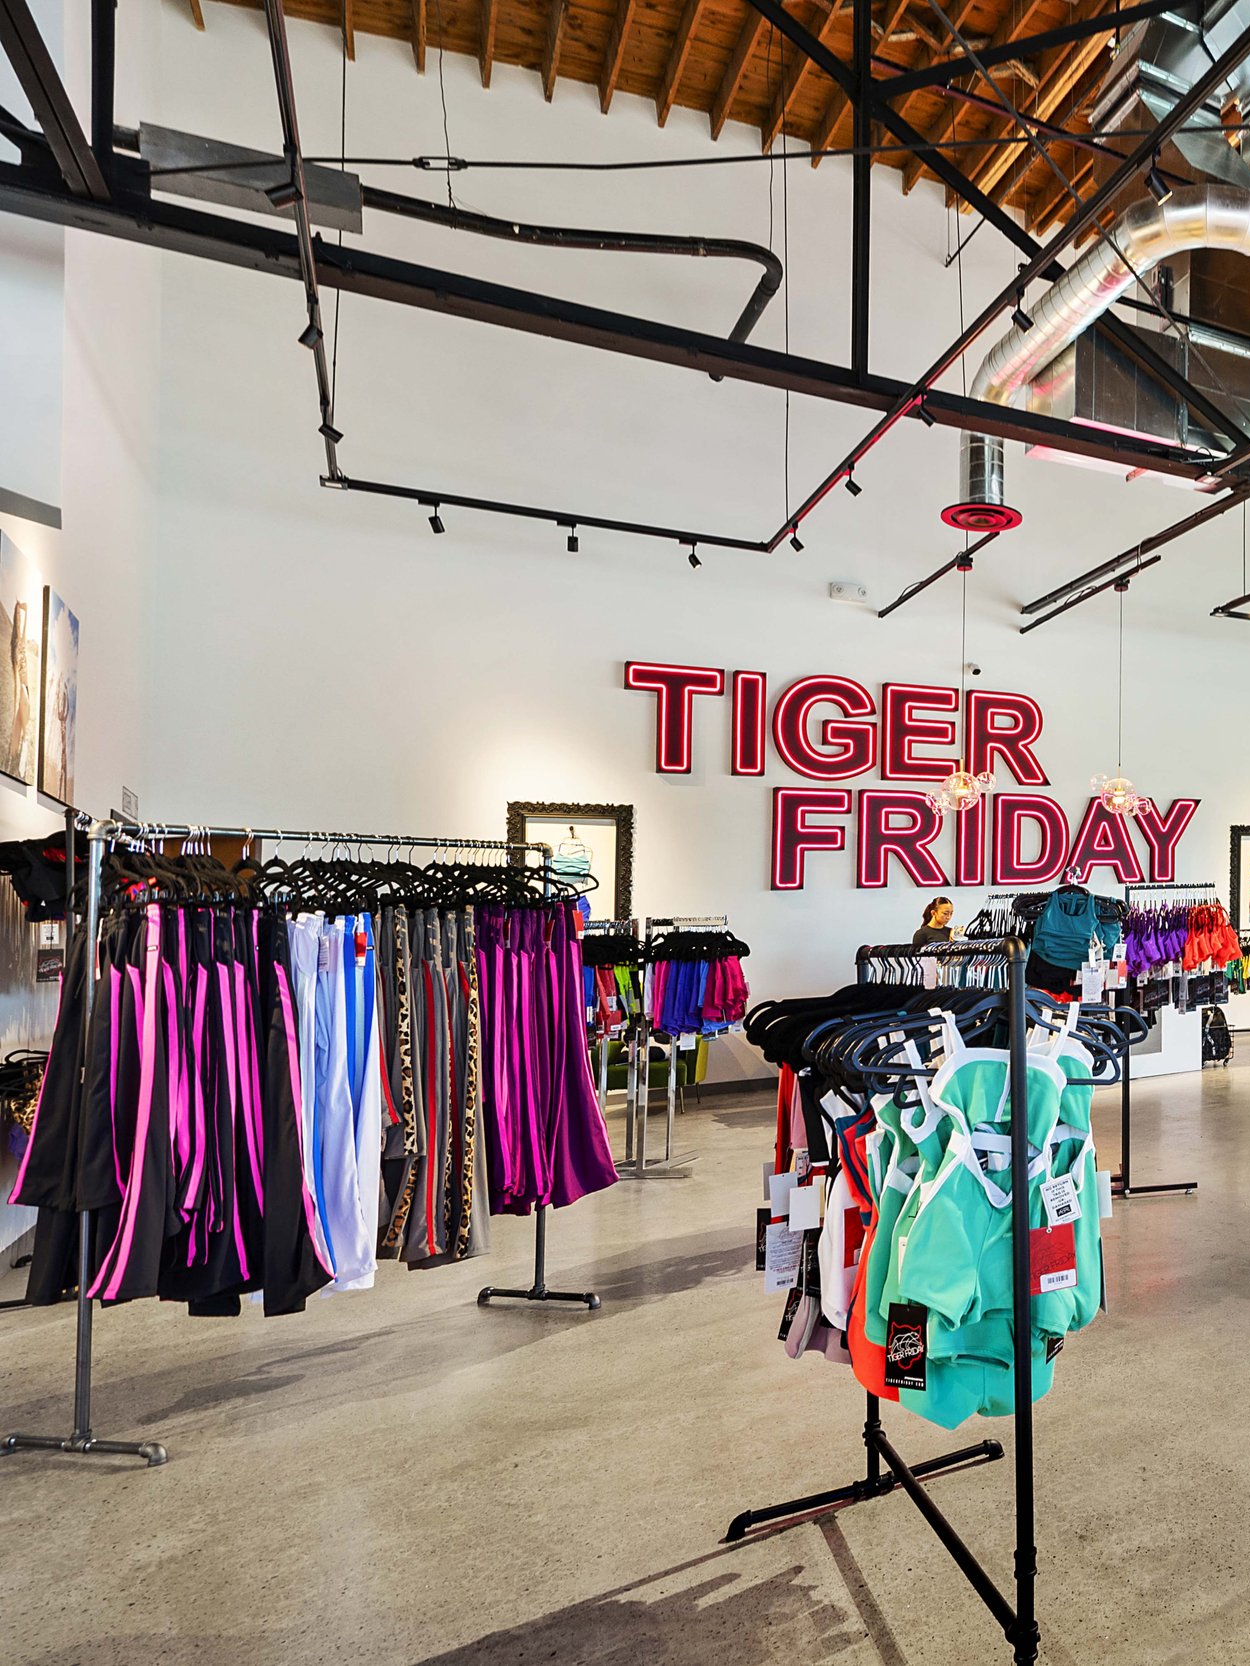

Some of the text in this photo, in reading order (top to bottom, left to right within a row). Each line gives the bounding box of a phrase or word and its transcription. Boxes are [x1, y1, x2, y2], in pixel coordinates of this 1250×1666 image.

[624, 660, 1051, 786] TIGER
[771, 786, 1202, 891] FRIDAY
[887, 1345, 924, 1362] TIGER FRIDAY
